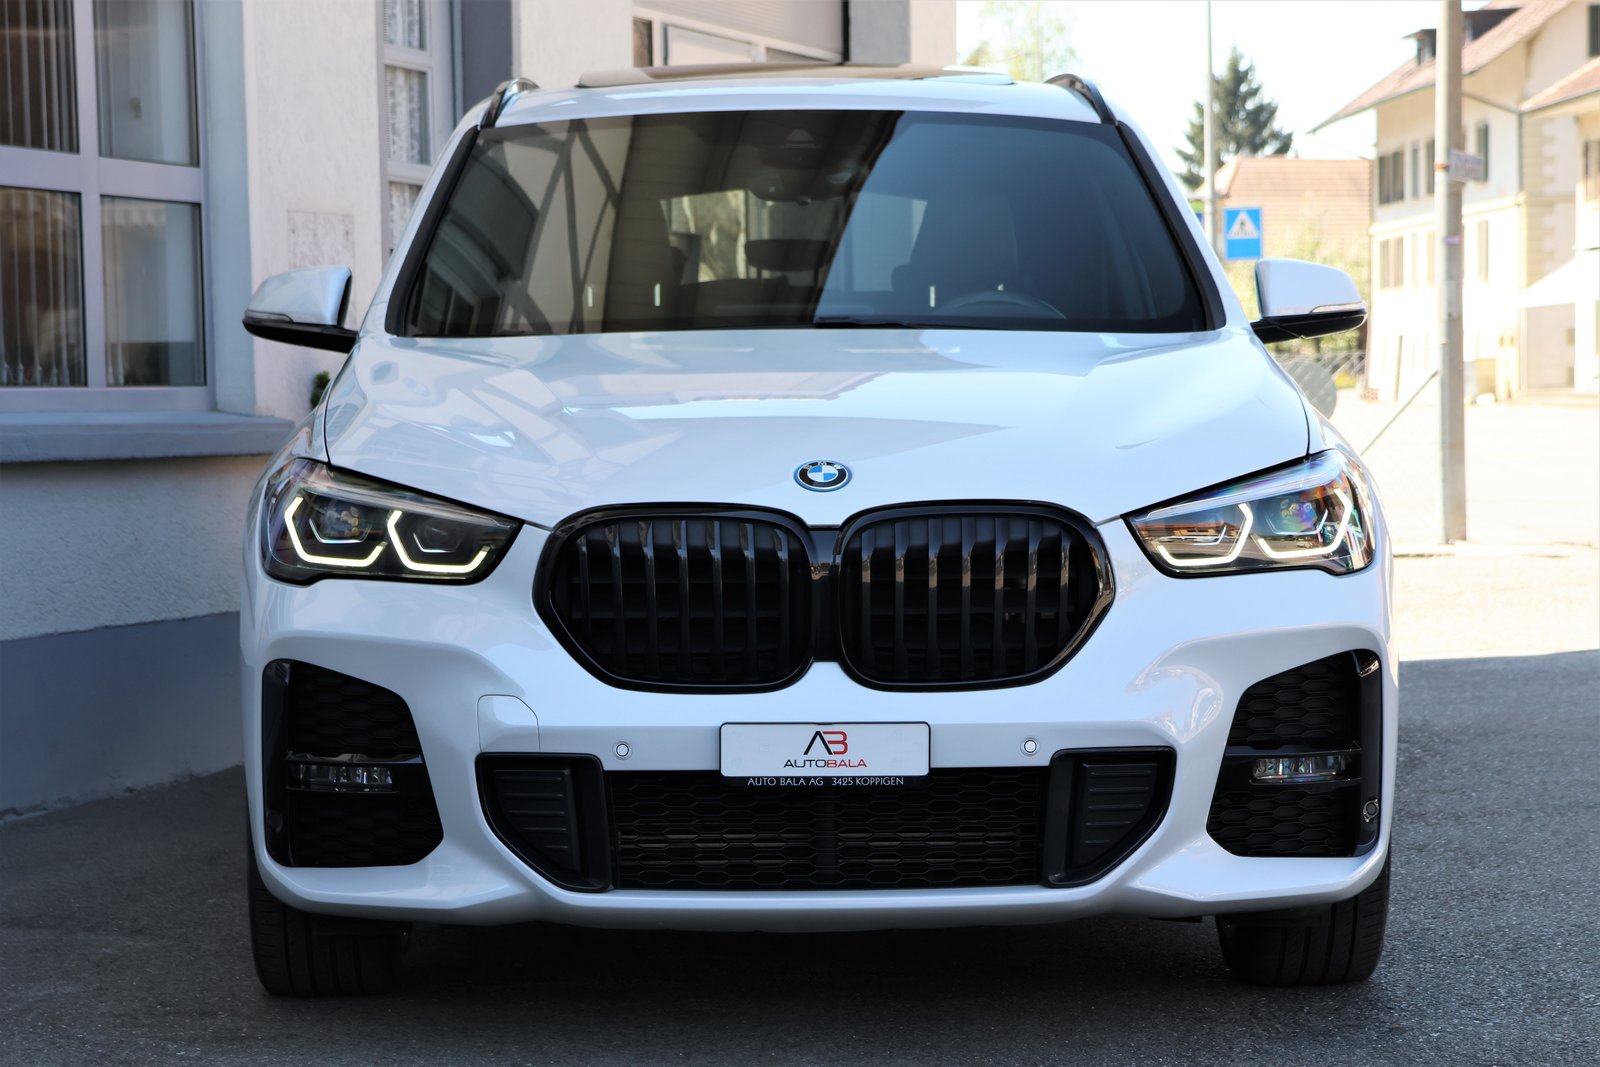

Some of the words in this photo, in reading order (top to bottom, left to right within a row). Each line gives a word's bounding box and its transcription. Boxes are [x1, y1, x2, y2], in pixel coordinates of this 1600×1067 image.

[803, 730, 849, 755] AB
[783, 759, 868, 768] AUTOBALA
[748, 777, 776, 786] AUTO
[780, 777, 806, 786] BALA
[808, 777, 824, 786] AG
[831, 777, 853, 786] 3425
[855, 776, 904, 786] KOPPIGEN
